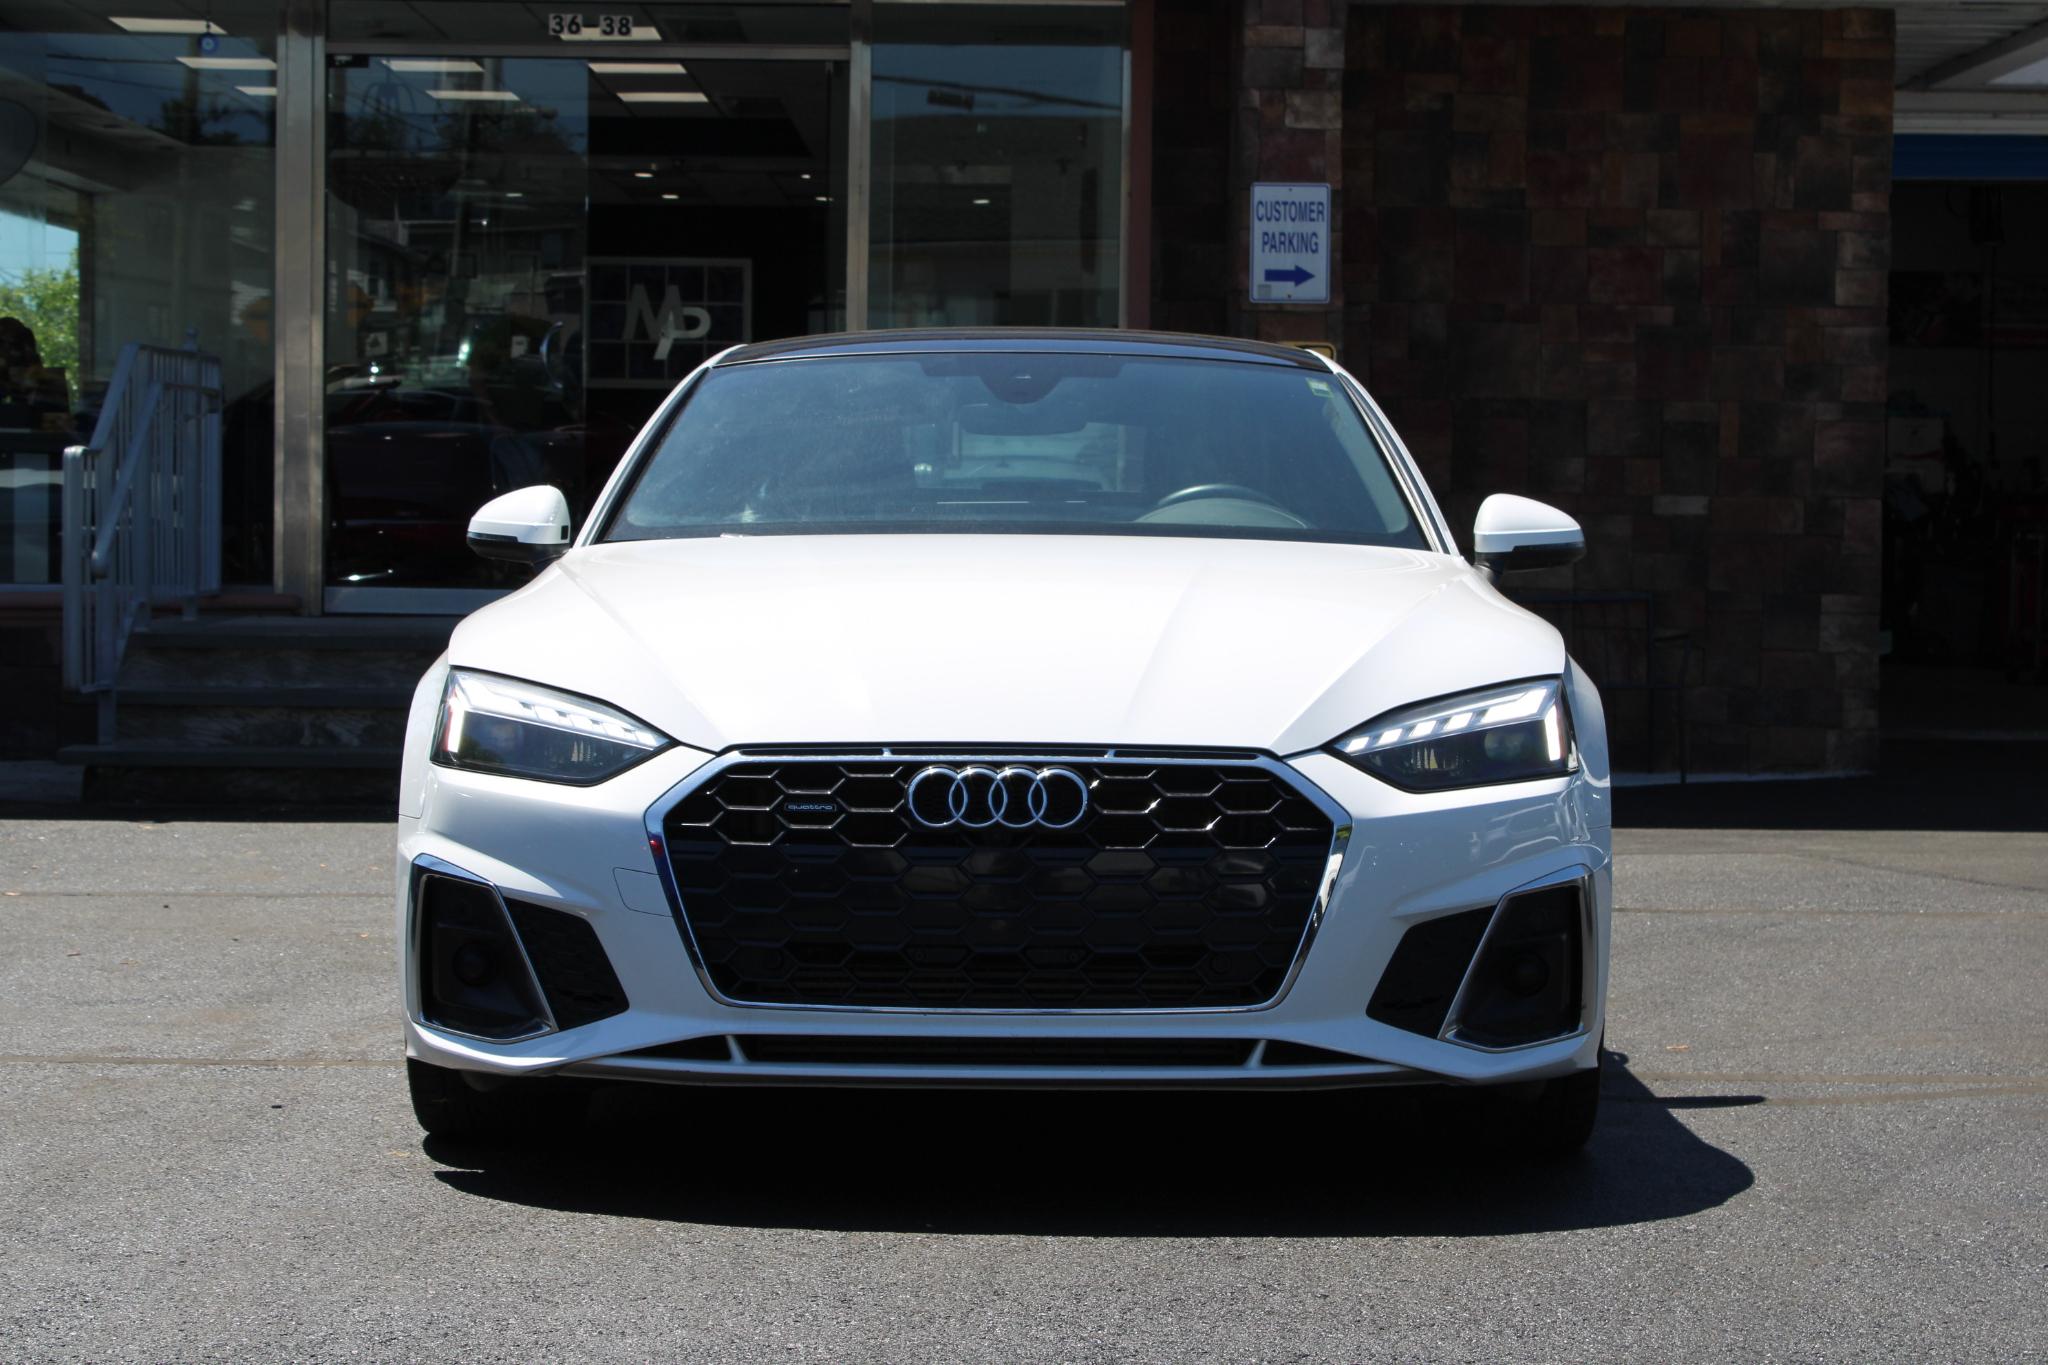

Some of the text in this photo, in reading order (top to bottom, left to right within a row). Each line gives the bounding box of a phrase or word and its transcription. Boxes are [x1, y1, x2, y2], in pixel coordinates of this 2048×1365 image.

[551, 14, 631, 36] 36 38
[1255, 201, 1325, 222] CUSTOMER
[1262, 232, 1319, 253] PARKING
[787, 803, 833, 811] quattro
